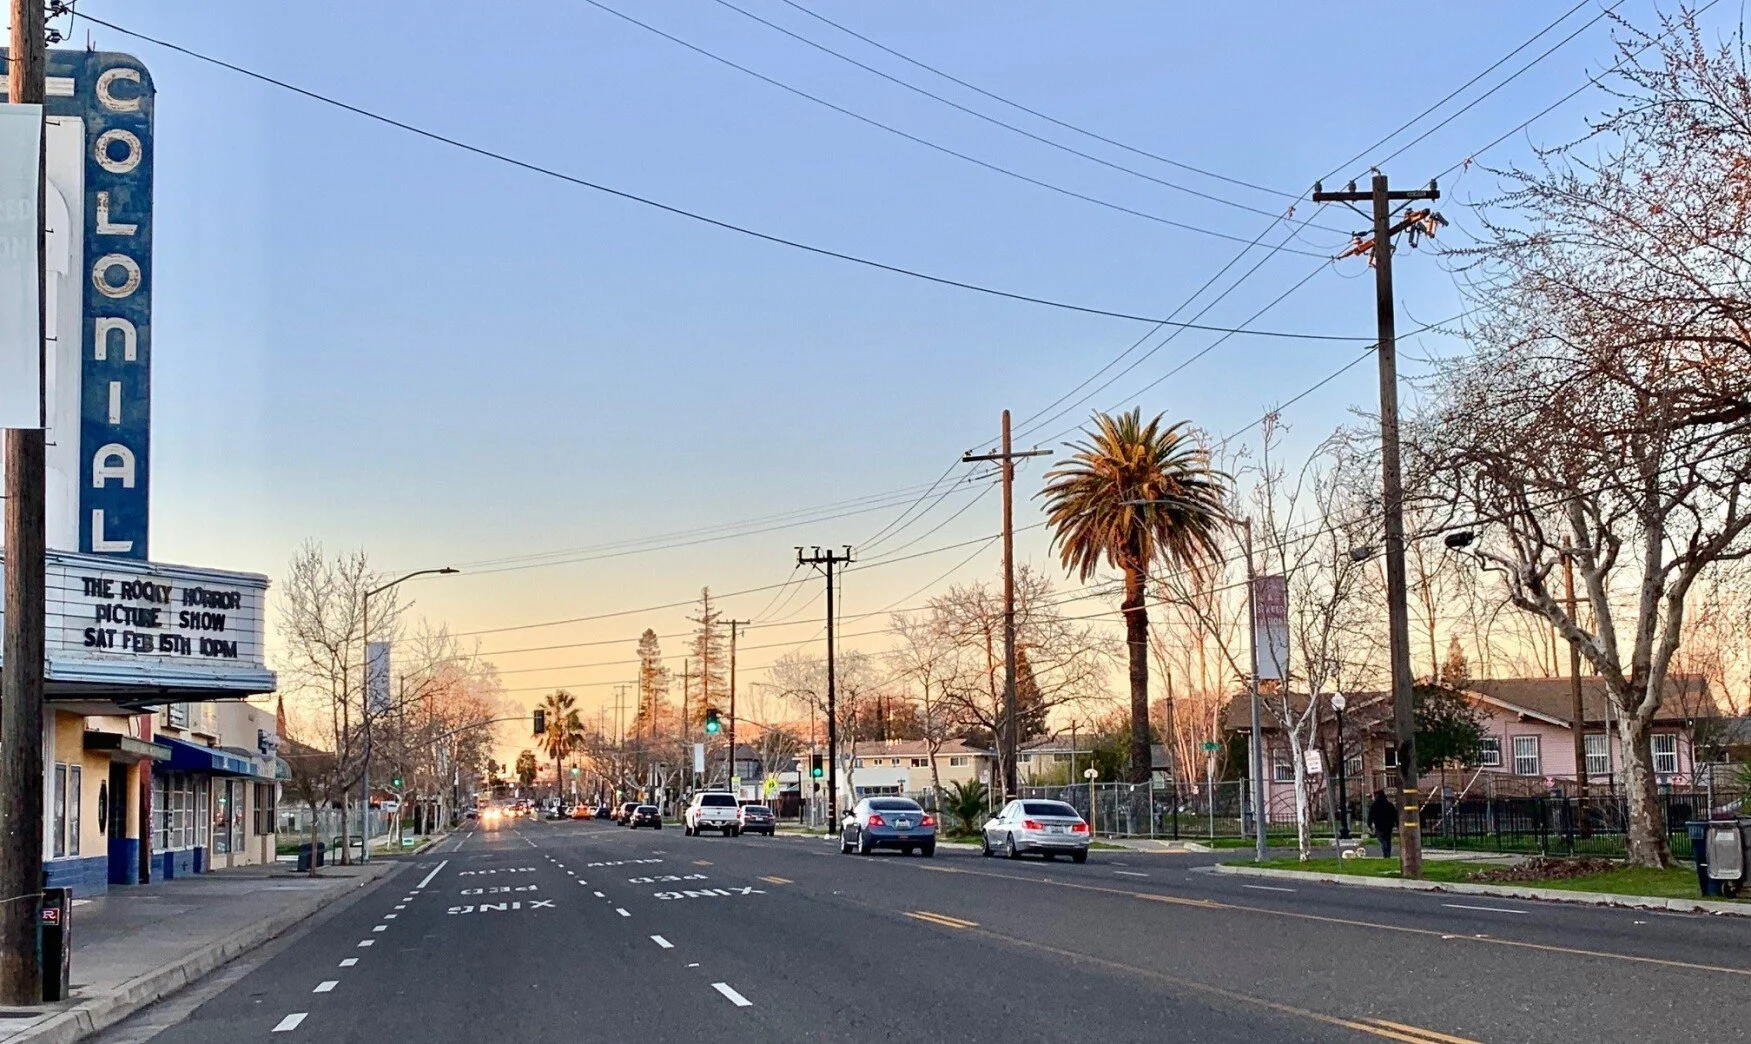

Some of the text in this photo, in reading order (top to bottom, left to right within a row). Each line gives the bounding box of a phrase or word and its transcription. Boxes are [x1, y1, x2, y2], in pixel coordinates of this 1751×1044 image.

[92, 67, 142, 552] COLONIAL
[81, 576, 242, 610] THE ROCKY HORROR
[95, 603, 226, 632] PICTURE SHOW
[84, 627, 238, 658] SAT FEB 15TH 10PM
[447, 899, 556, 914] XING
[653, 886, 767, 900] XING
